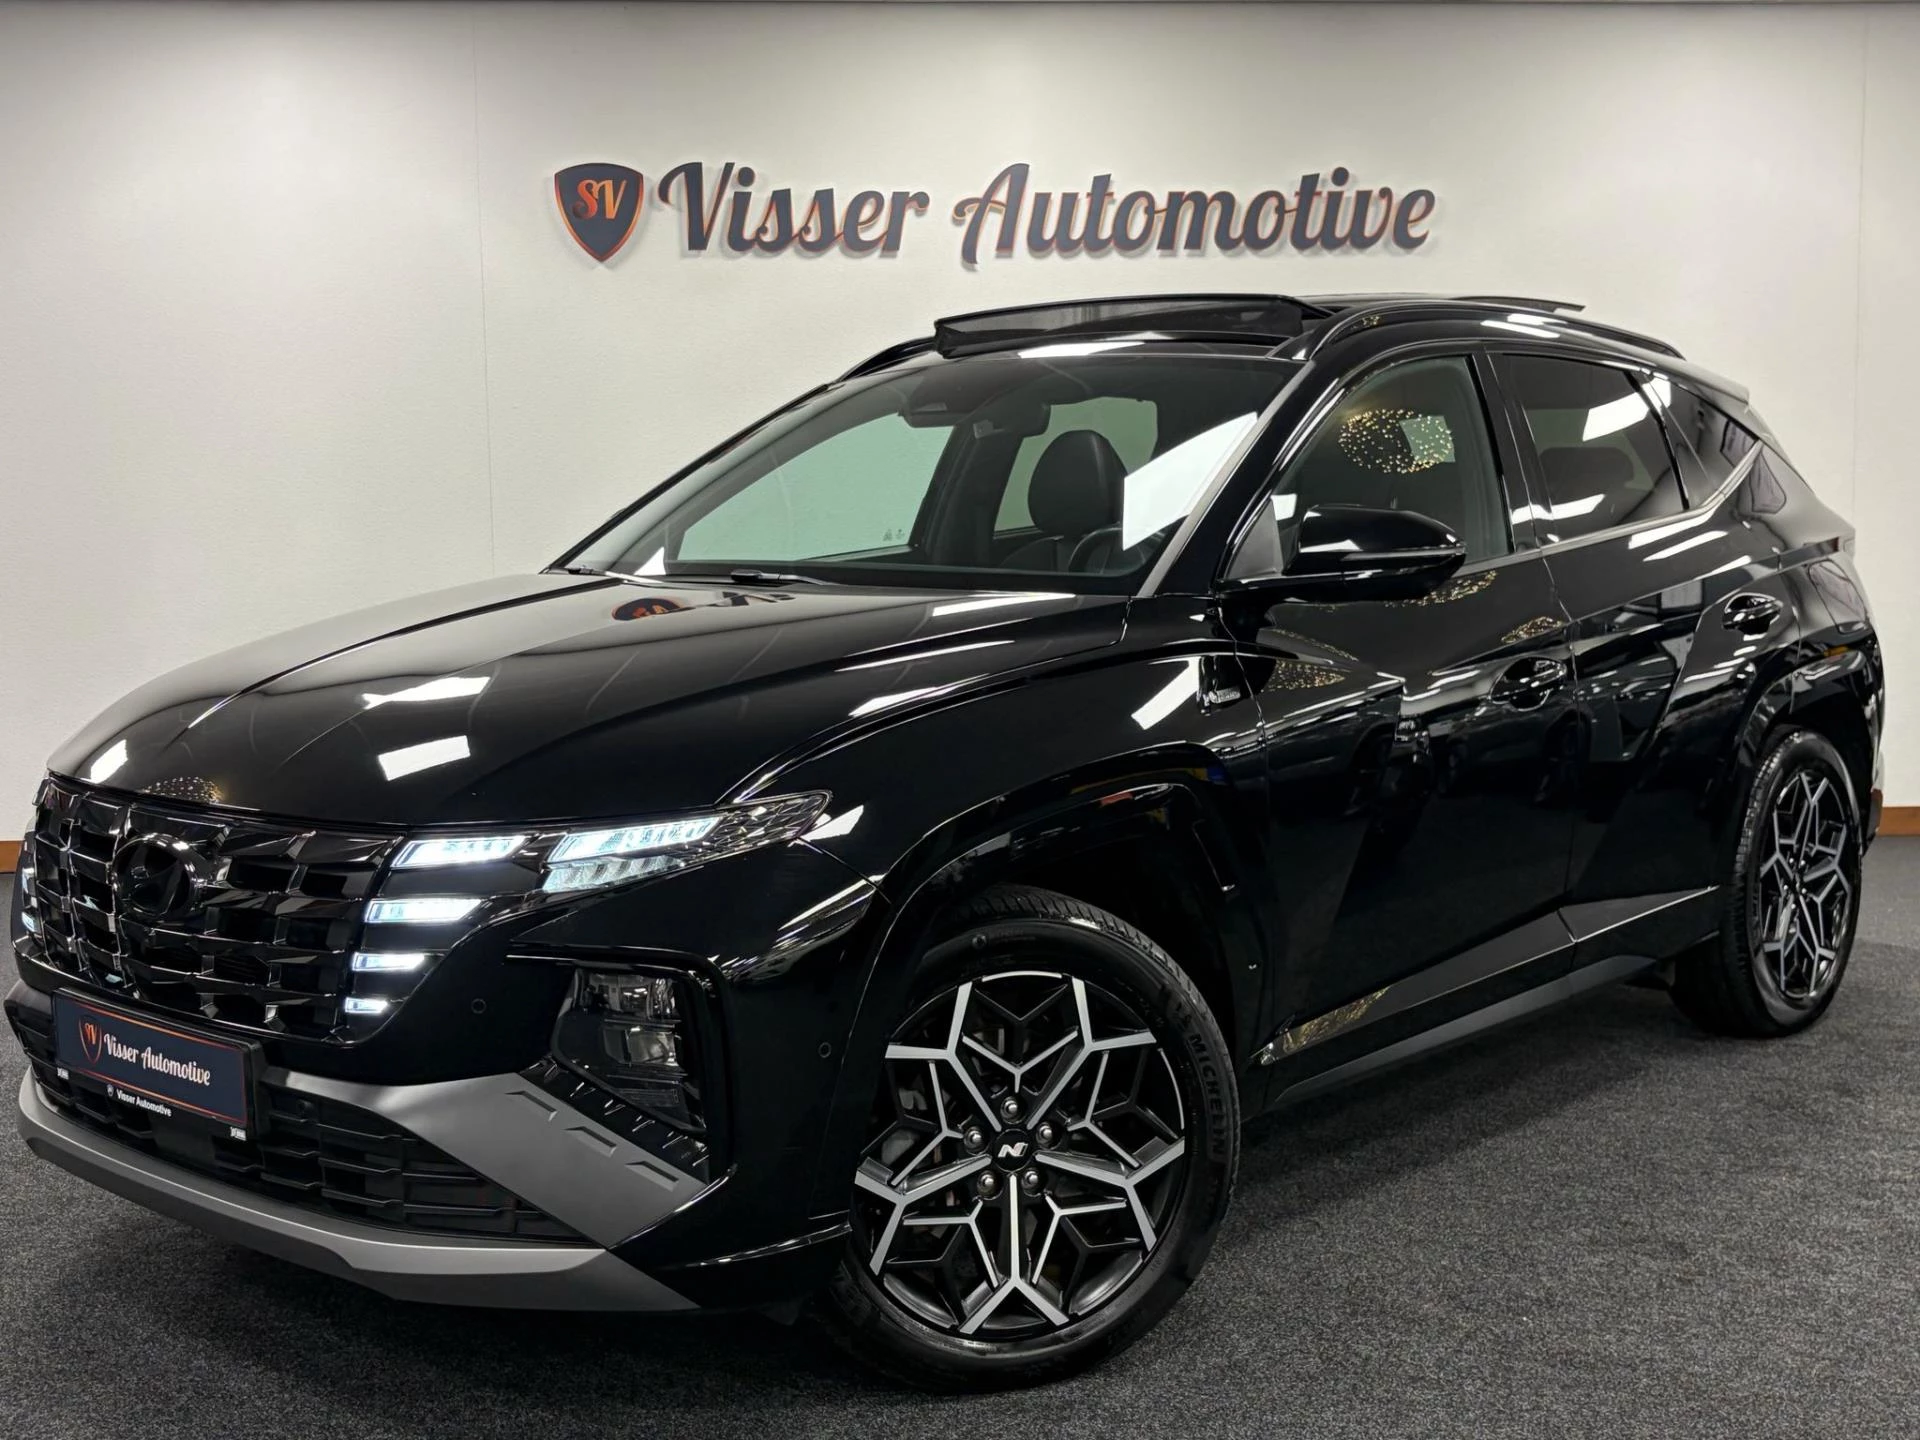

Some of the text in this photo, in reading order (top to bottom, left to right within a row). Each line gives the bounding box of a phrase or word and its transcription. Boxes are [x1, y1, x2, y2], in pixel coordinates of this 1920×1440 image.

[572, 161, 1436, 265] SV Visser Automotive
[103, 1033, 139, 1064] Visser
[141, 1046, 211, 1086] Automotive
[1189, 1033, 1226, 1156] MICHELIN
[116, 1088, 172, 1117] Visser Automotive
